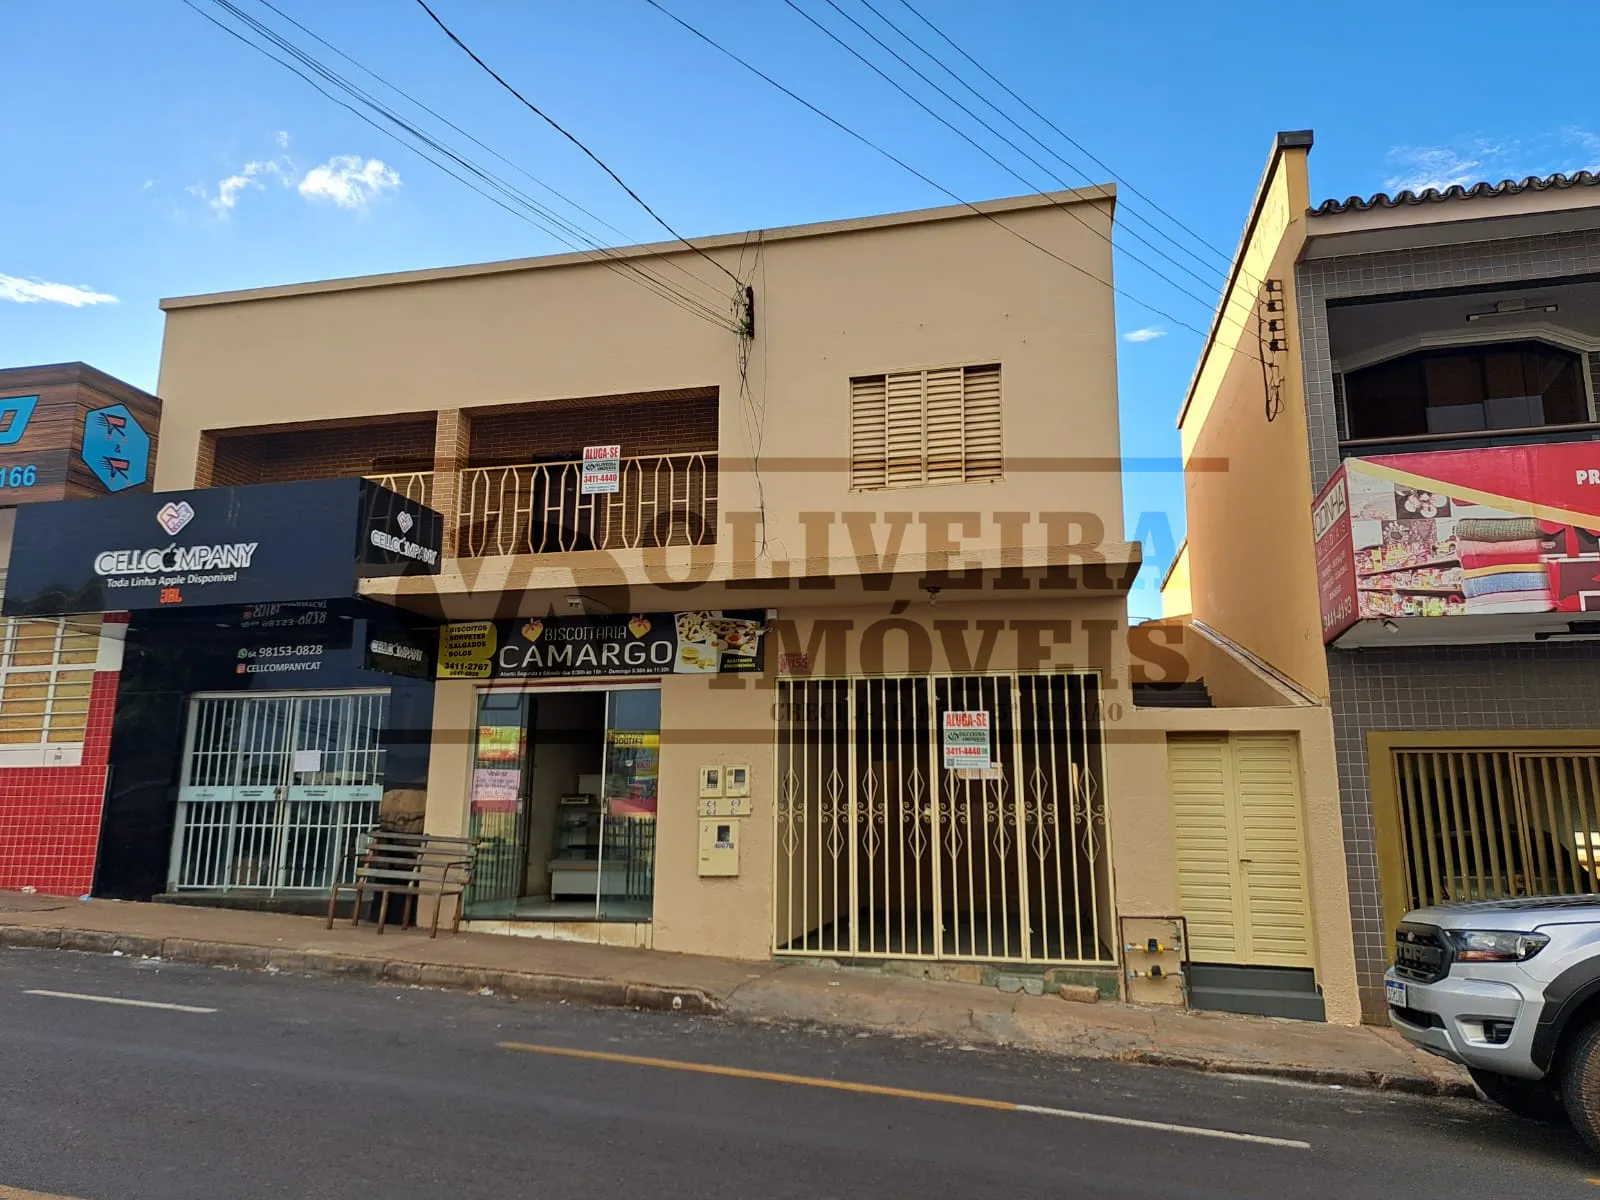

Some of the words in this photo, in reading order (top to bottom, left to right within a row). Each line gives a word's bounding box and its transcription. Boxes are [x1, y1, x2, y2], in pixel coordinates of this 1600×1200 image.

[585, 447, 619, 460] ALUGA-SE
[107, 579, 130, 588] Toda
[131, 577, 157, 587] Linha
[158, 575, 186, 587] Apple
[449, 624, 488, 634] BISCOITOS
[449, 633, 486, 641] SORVETES
[448, 641, 487, 649] SALGADOS
[258, 645, 324, 659] 98153-0828
[448, 649, 473, 657] BOLOS
[499, 640, 673, 669] CAMARGO
[247, 662, 322, 674] CELLCOMPANYCAT
[444, 662, 489, 671] 3411-2767
[608, 668, 631, 676] Domingo
[945, 713, 987, 727] ALUGA-SE
[945, 746, 981, 755] 3411-4440
